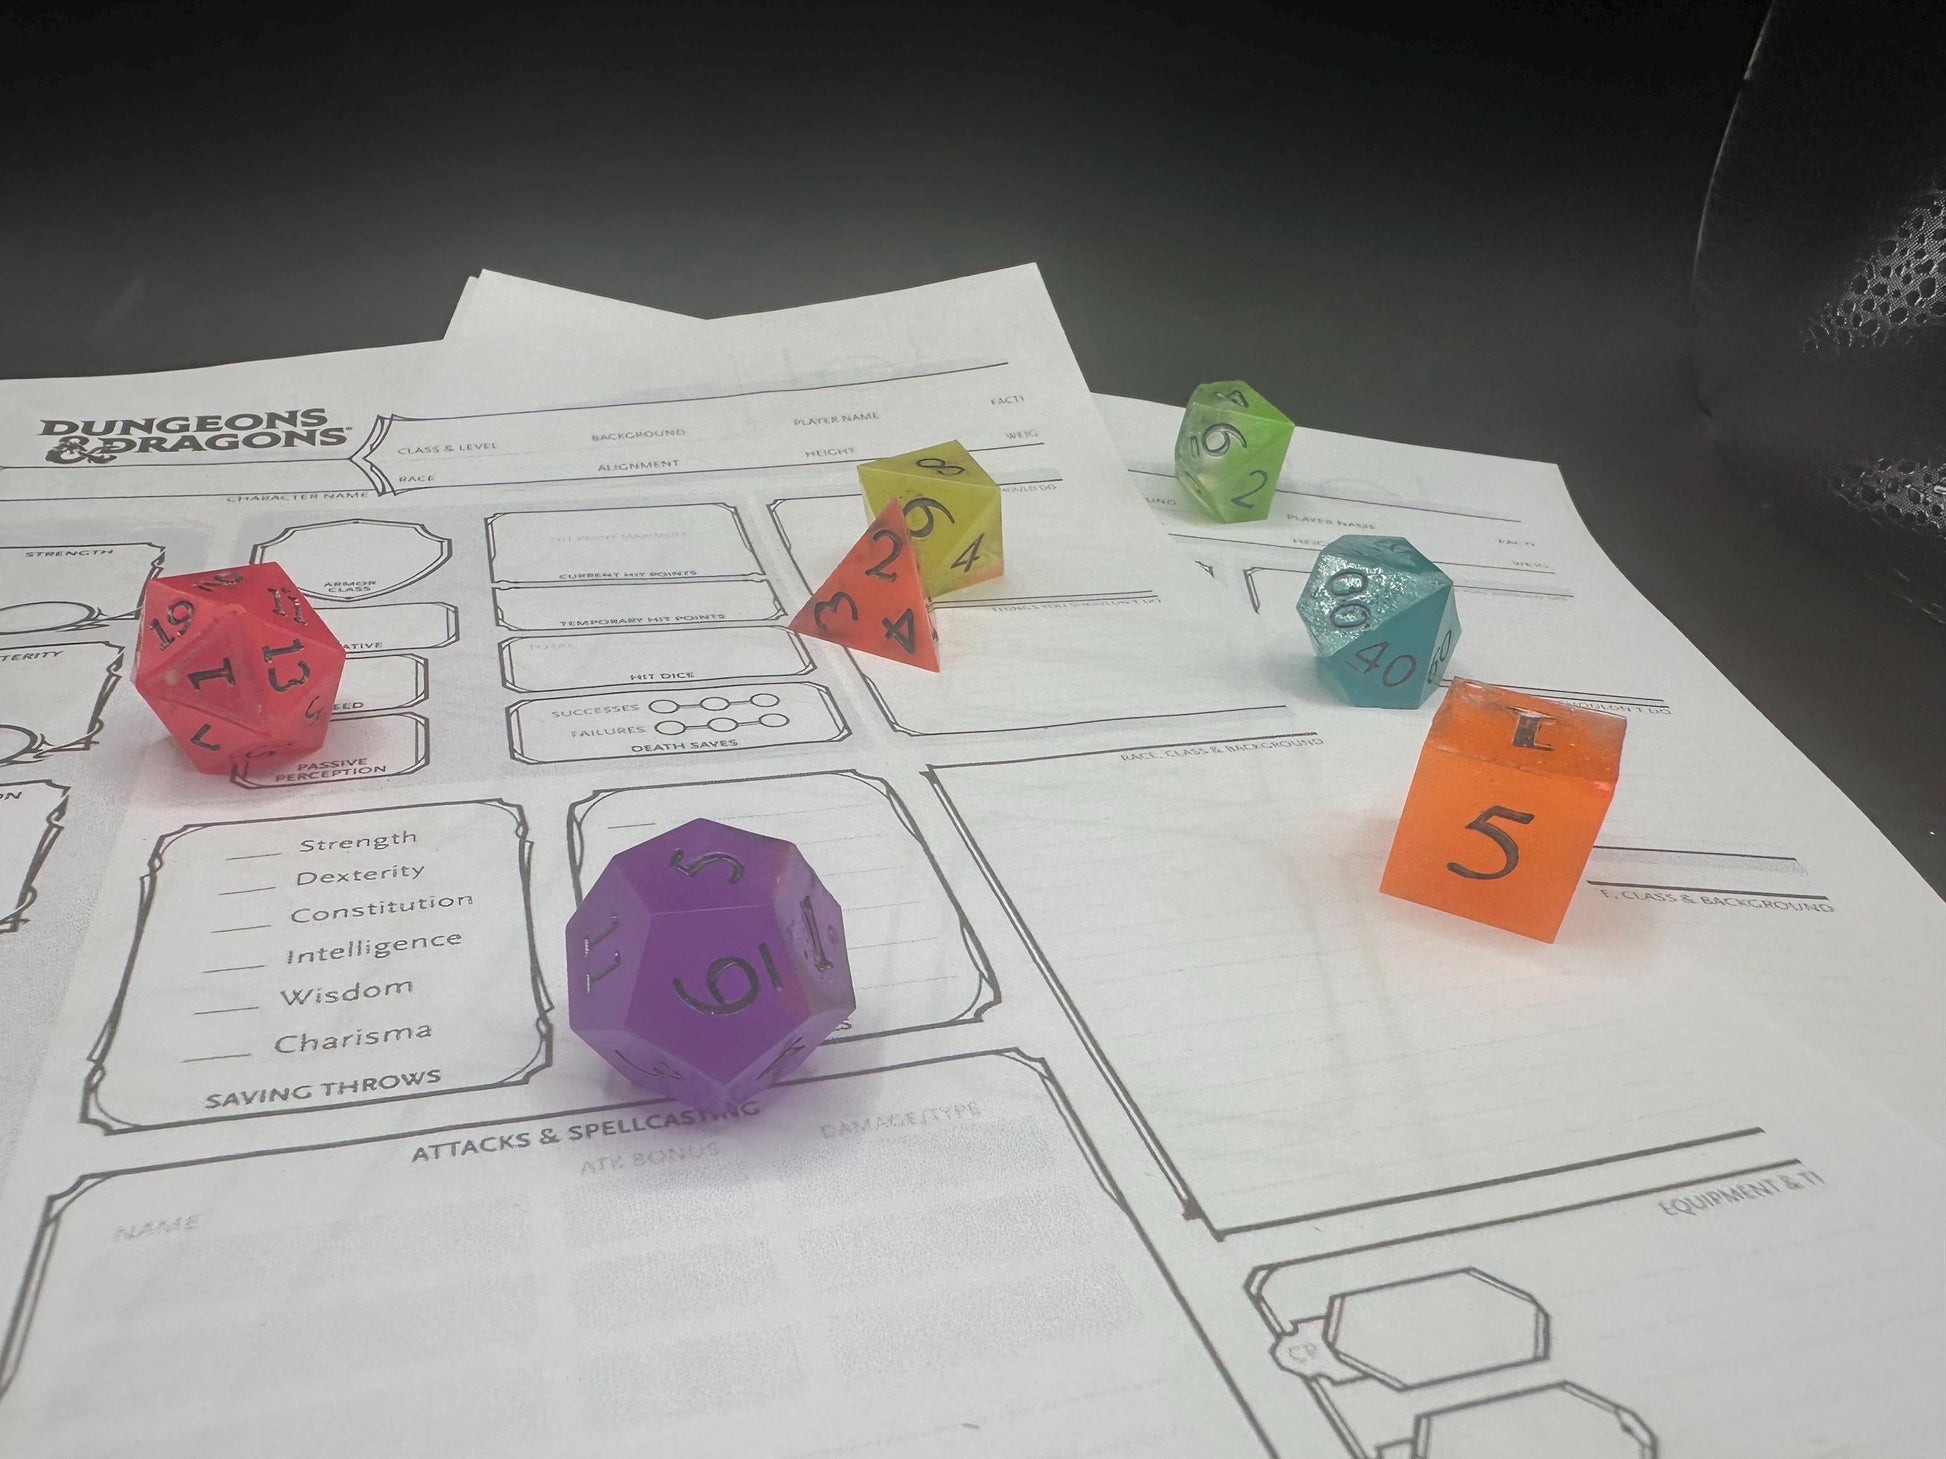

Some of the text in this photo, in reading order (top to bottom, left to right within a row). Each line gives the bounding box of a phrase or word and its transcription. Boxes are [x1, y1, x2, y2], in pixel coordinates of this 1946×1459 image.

[40, 408, 328, 436] DUNGEONS
[793, 411, 881, 427] PLAYER NAME
[98, 427, 348, 454] DRAGONS
[592, 428, 686, 442] BACKGROUND
[398, 446, 440, 456] CLASS
[459, 442, 497, 452] LEVEL
[805, 447, 855, 458] HEIGHT
[598, 459, 680, 472] ALIGNMENT
[399, 474, 434, 483] RACE
[1230, 469, 1269, 510] 2
[226, 491, 369, 503] CHARACTER NAME
[25, 548, 114, 558] STRENGTH
[864, 528, 903, 583] 2
[949, 533, 985, 573] 4
[559, 617, 643, 627] TEMPORARY
[675, 613, 726, 622] POINTS
[813, 591, 859, 635] 3
[630, 671, 695, 681] HIT DICE
[551, 703, 641, 719] SUCCESSES
[571, 725, 647, 738] FAILURES
[631, 738, 739, 753] DEATH SAVES
[1166, 748, 1209, 758] CLASS
[1225, 738, 1325, 753] BACKGROUND
[275, 765, 387, 783] PERCEPTION
[297, 758, 368, 771] PASSIVE
[299, 830, 417, 853] Strength
[1446, 805, 1535, 880] 5
[296, 864, 425, 887] Dexterity
[290, 893, 474, 924] Constitution
[1621, 890, 1678, 902] CLASS
[1700, 895, 1836, 913] BACKGROUND
[287, 931, 463, 965] Intelligence
[279, 978, 414, 1008] Wisdom
[274, 1022, 433, 1055] Charisma
[204, 1068, 442, 1110] SAVING THROWS
[411, 1132, 531, 1163] ATTACKS
[539, 1127, 561, 1146] &
[632, 1142, 722, 1166] BONUS
[1658, 1178, 1781, 1216] EQUIPMENT
[1776, 1174, 1807, 1191] &
